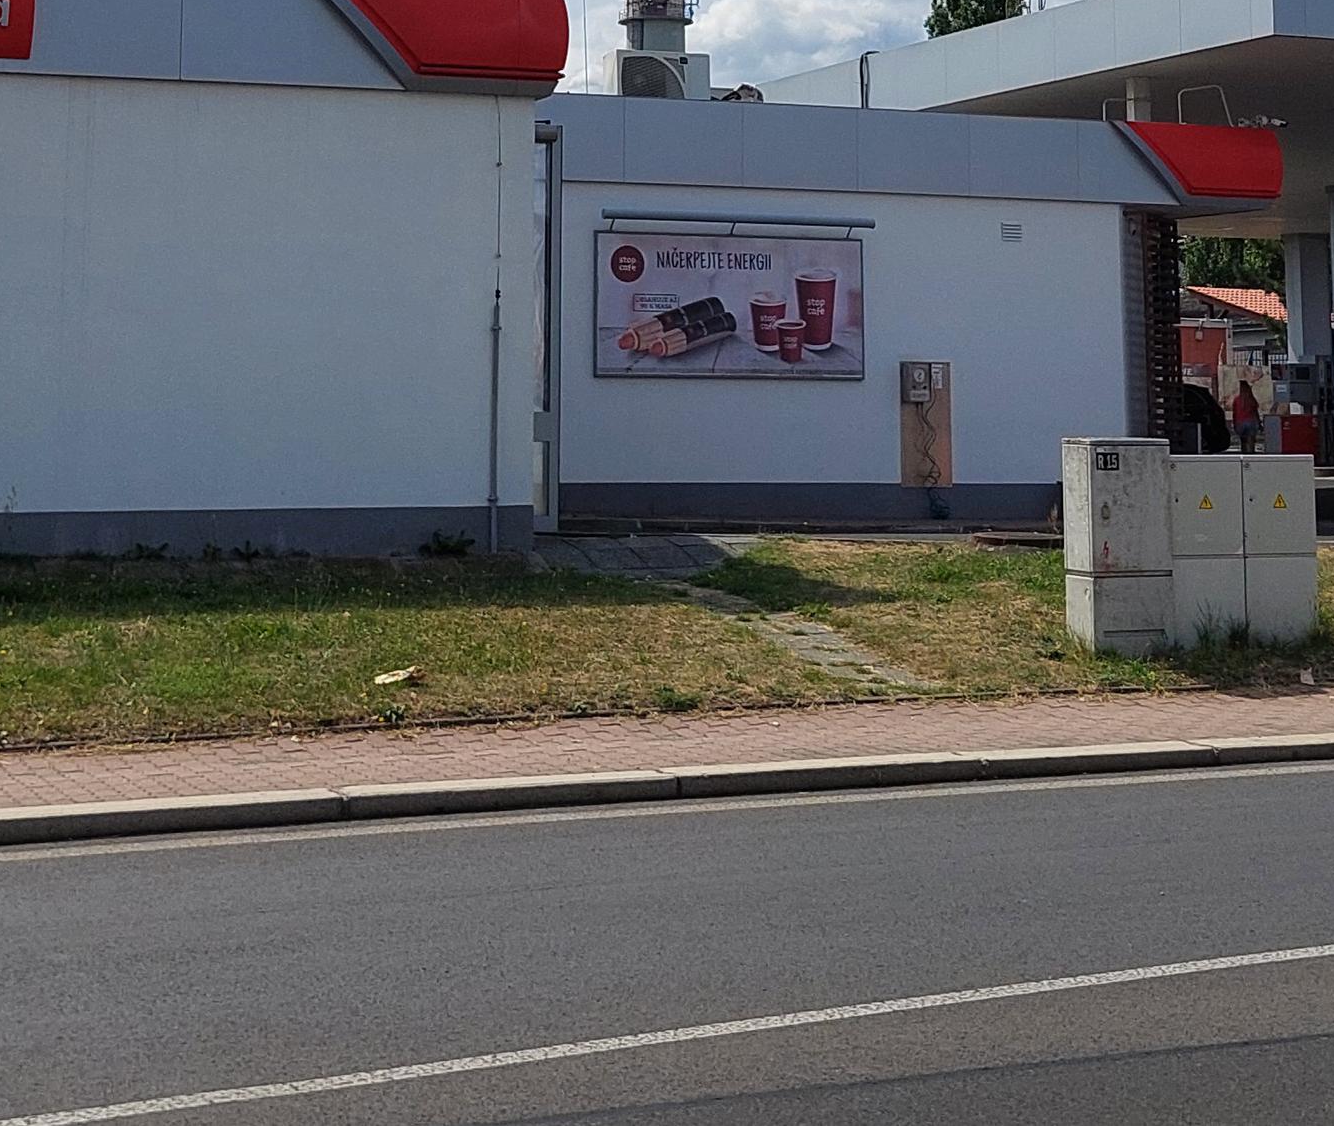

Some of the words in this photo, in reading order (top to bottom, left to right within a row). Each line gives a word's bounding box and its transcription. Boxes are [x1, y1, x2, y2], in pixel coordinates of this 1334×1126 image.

[656, 247, 725, 270] NAČERPEJTE
[727, 252, 772, 271] ENERGII
[1098, 454, 1105, 469] R
[1107, 454, 1118, 469] 15
